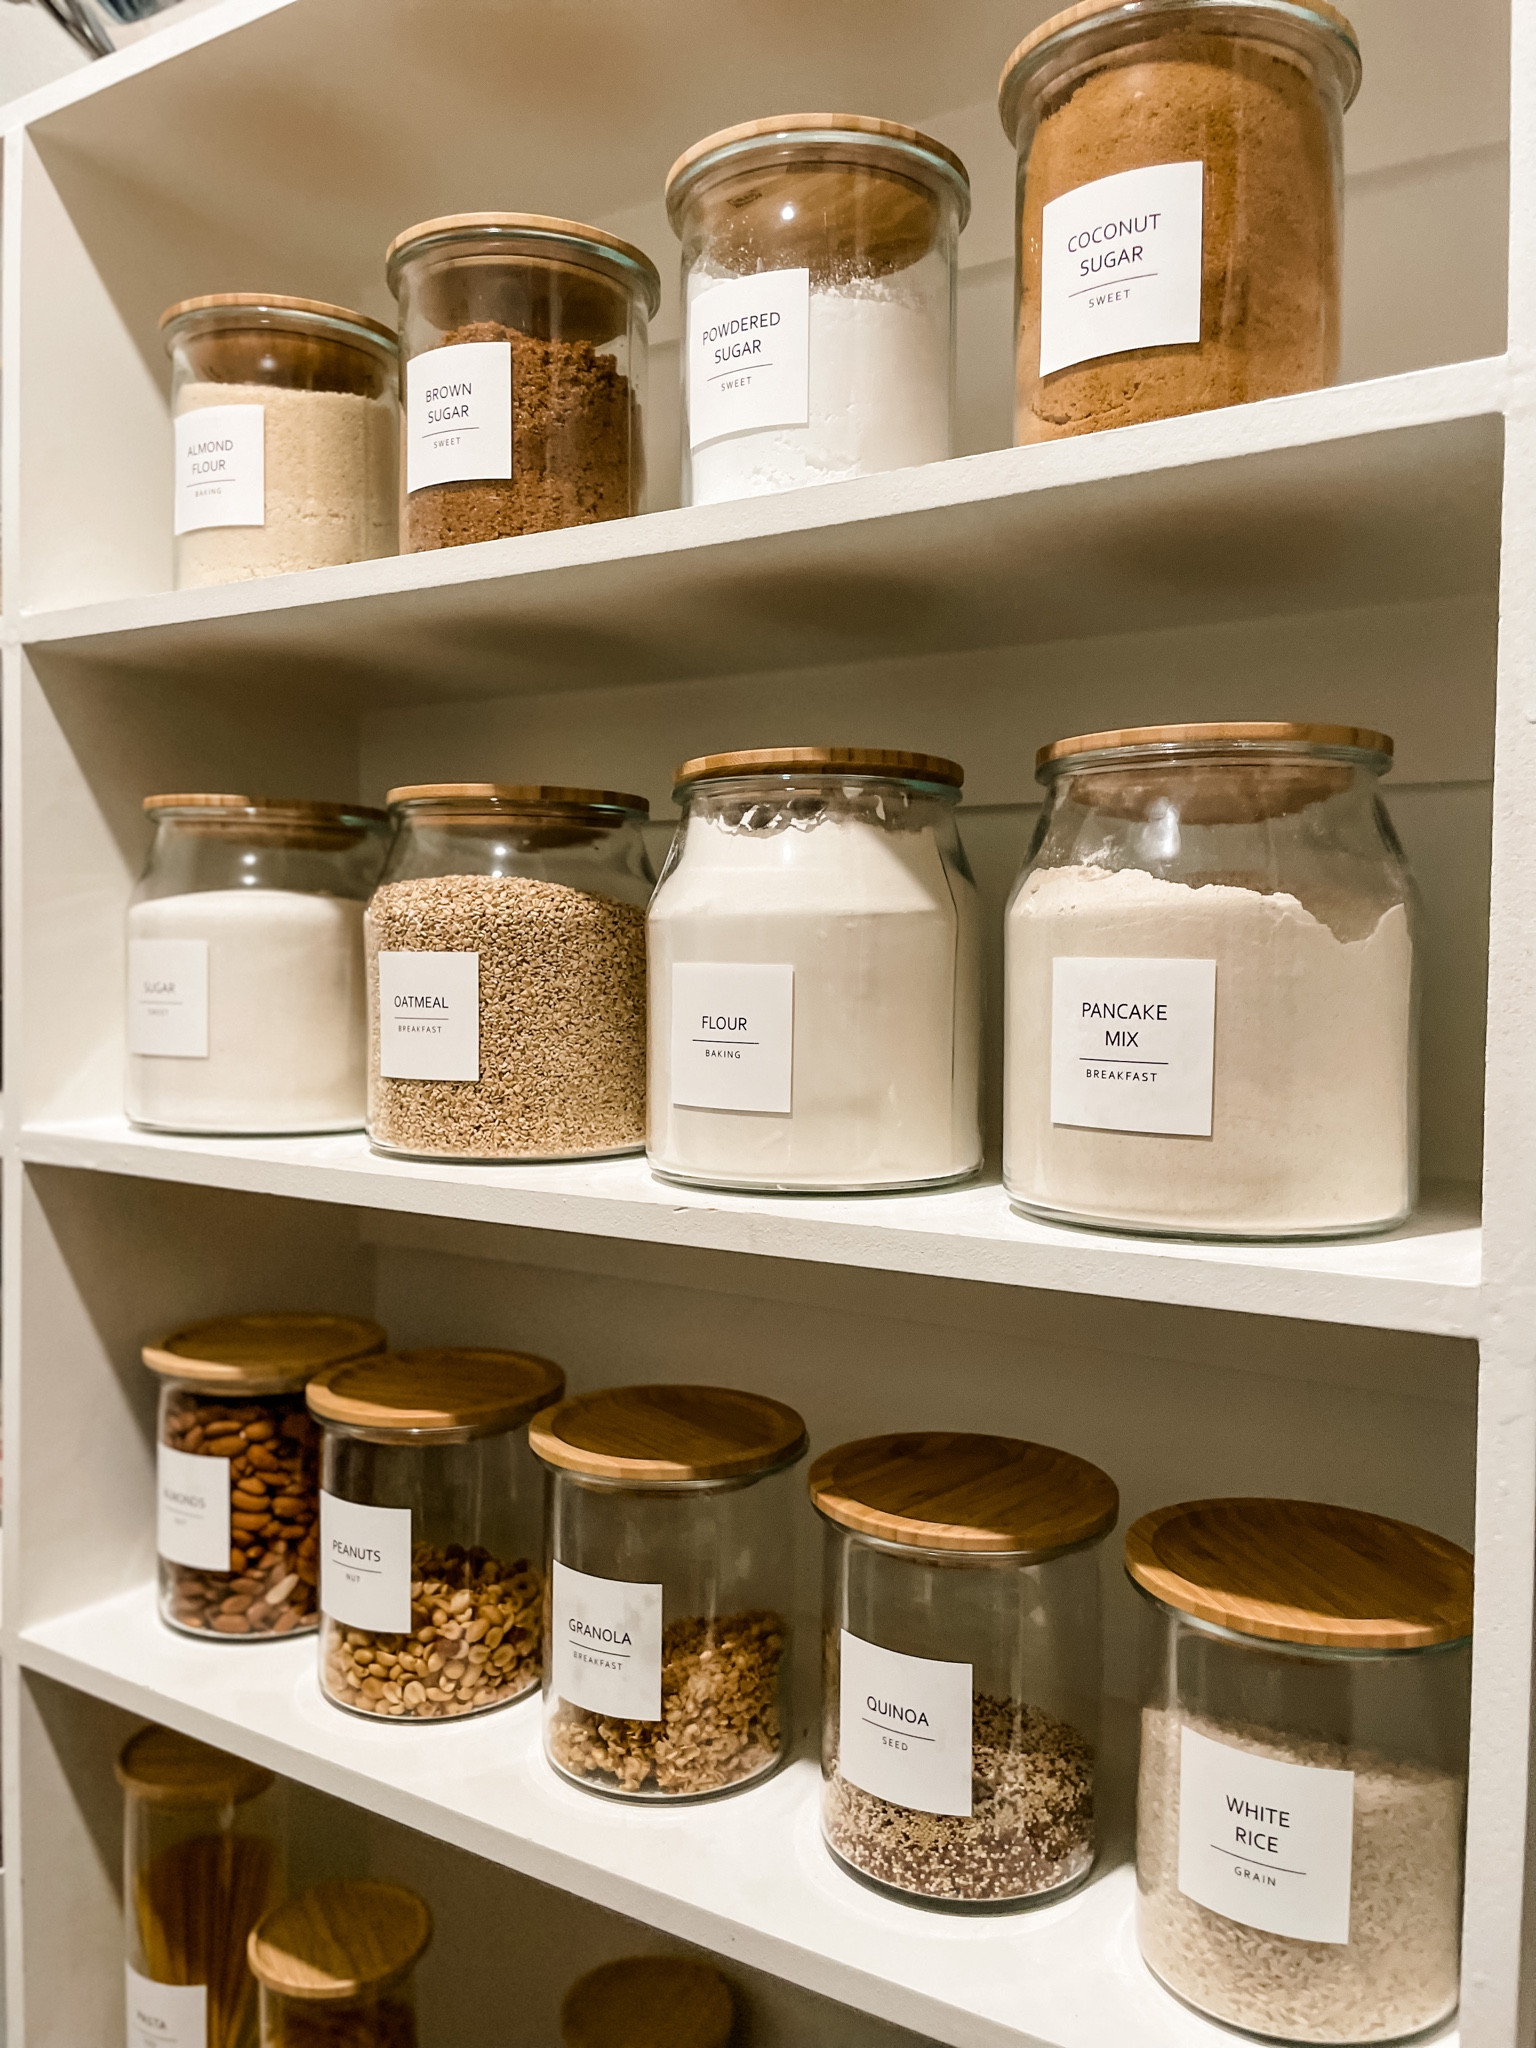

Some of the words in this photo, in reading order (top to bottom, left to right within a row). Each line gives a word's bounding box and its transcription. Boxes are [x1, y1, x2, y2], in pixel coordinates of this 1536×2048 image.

[1067, 212, 1162, 253] COCONUT
[1079, 245, 1144, 277] SUGAR
[1088, 288, 1131, 309] SWEET
[702, 312, 781, 346] POWDERED
[714, 339, 762, 364] SUGAR
[425, 382, 472, 403] BROWN
[721, 376, 752, 392] SWEET
[427, 404, 470, 424] SUGAR
[187, 439, 234, 458] ALMOND
[433, 436, 461, 449] SWEET
[191, 459, 226, 475] FLOUR
[394, 995, 449, 1009] OATMEAL
[1082, 1002, 1168, 1021] PANCAKE
[398, 1024, 442, 1034] BREAKFAST
[701, 1015, 748, 1031] FLOUR
[1105, 1030, 1139, 1048] MIX
[705, 1049, 741, 1059] BAKING
[1086, 1068, 1158, 1082] BREAKFAST
[332, 1539, 381, 1562] PEANUTS
[568, 1618, 632, 1645] GRANOLA
[573, 1650, 622, 1671] BREAKFAST
[866, 1695, 930, 1727] QUINOA
[882, 1736, 909, 1751] SEED
[1226, 1794, 1291, 1829] WHITE
[1234, 1825, 1280, 1854] RICE
[1233, 1865, 1277, 1888] GRAIN
